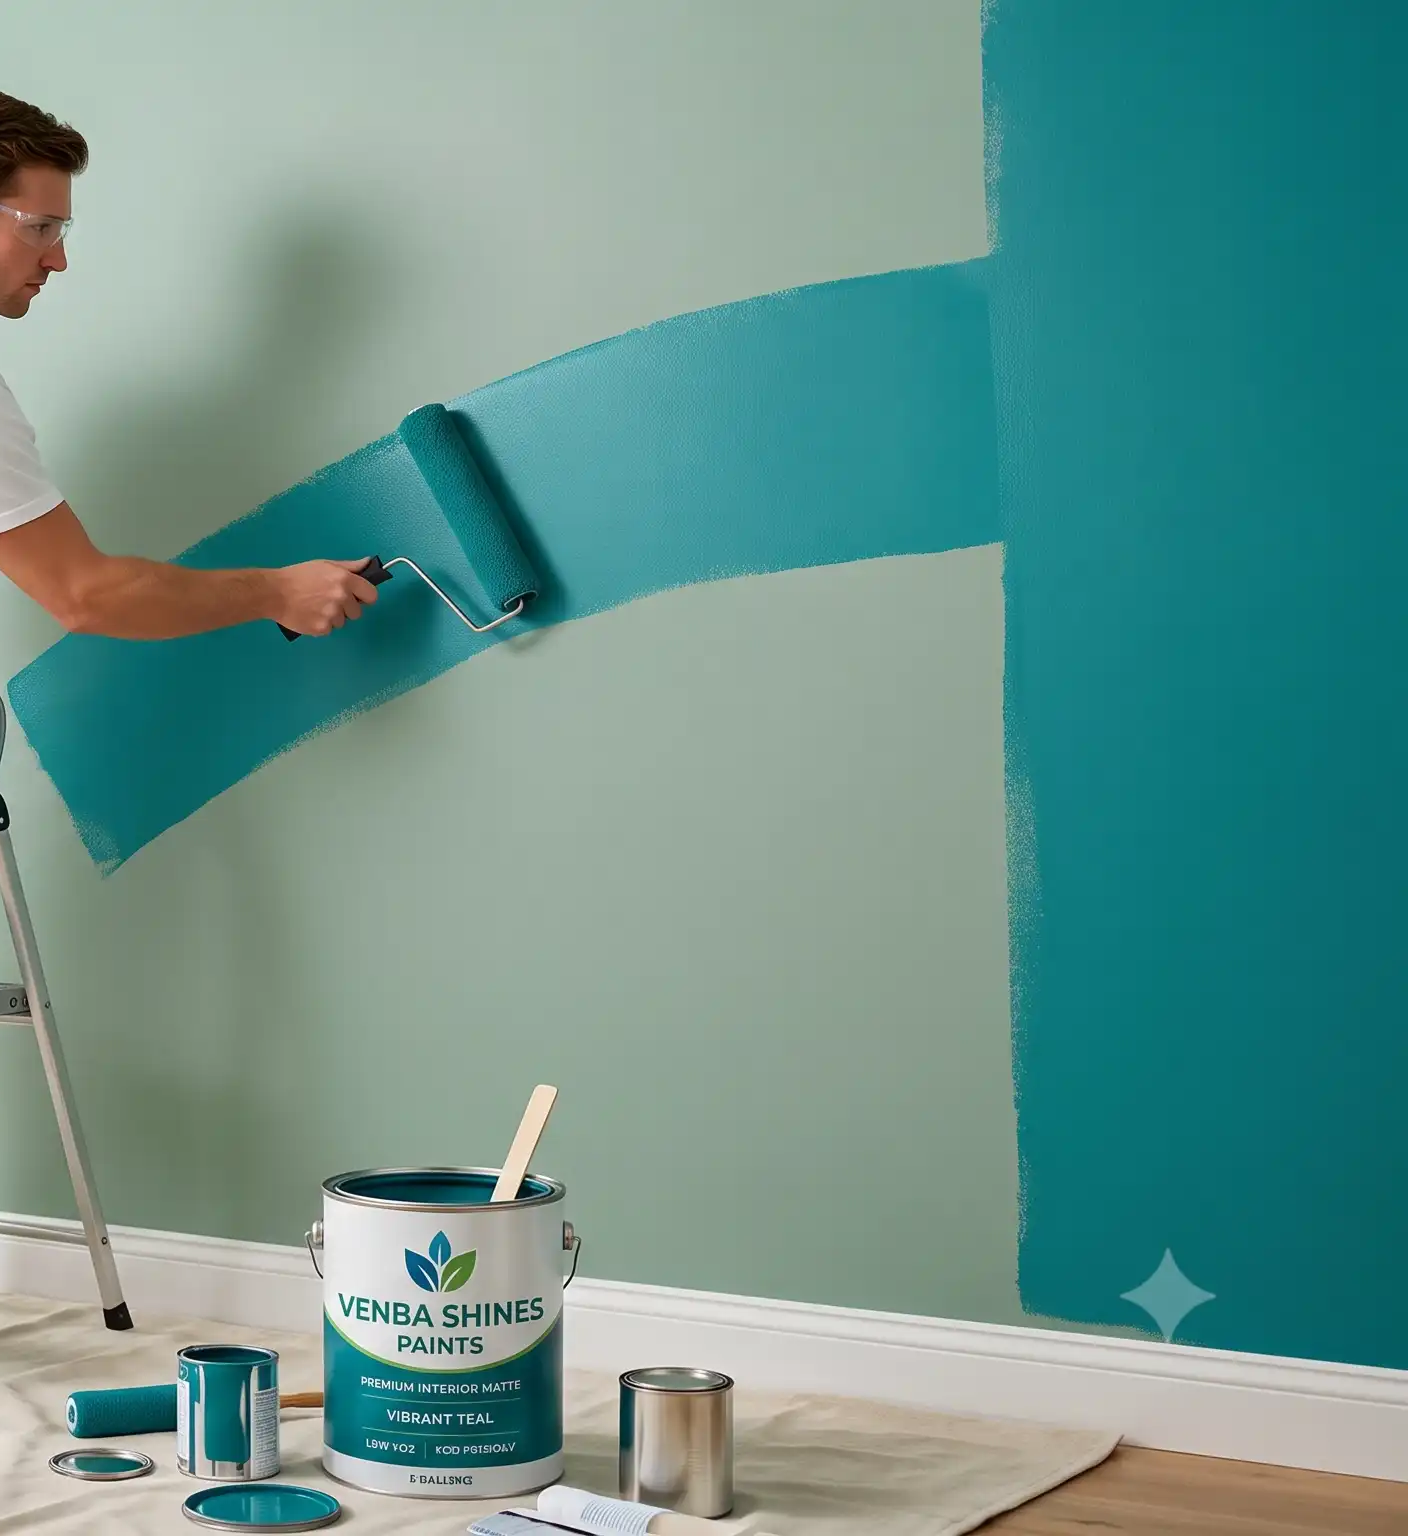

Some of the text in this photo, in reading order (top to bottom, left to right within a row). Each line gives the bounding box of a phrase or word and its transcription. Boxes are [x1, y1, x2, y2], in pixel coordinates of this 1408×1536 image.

[338, 1293, 544, 1328] VENBA SHINES
[397, 1335, 484, 1355] PAINTS
[361, 1376, 521, 1394] PREMIUM INTERIOR MATTE
[387, 1409, 494, 1425] VIBRANT TEAL
